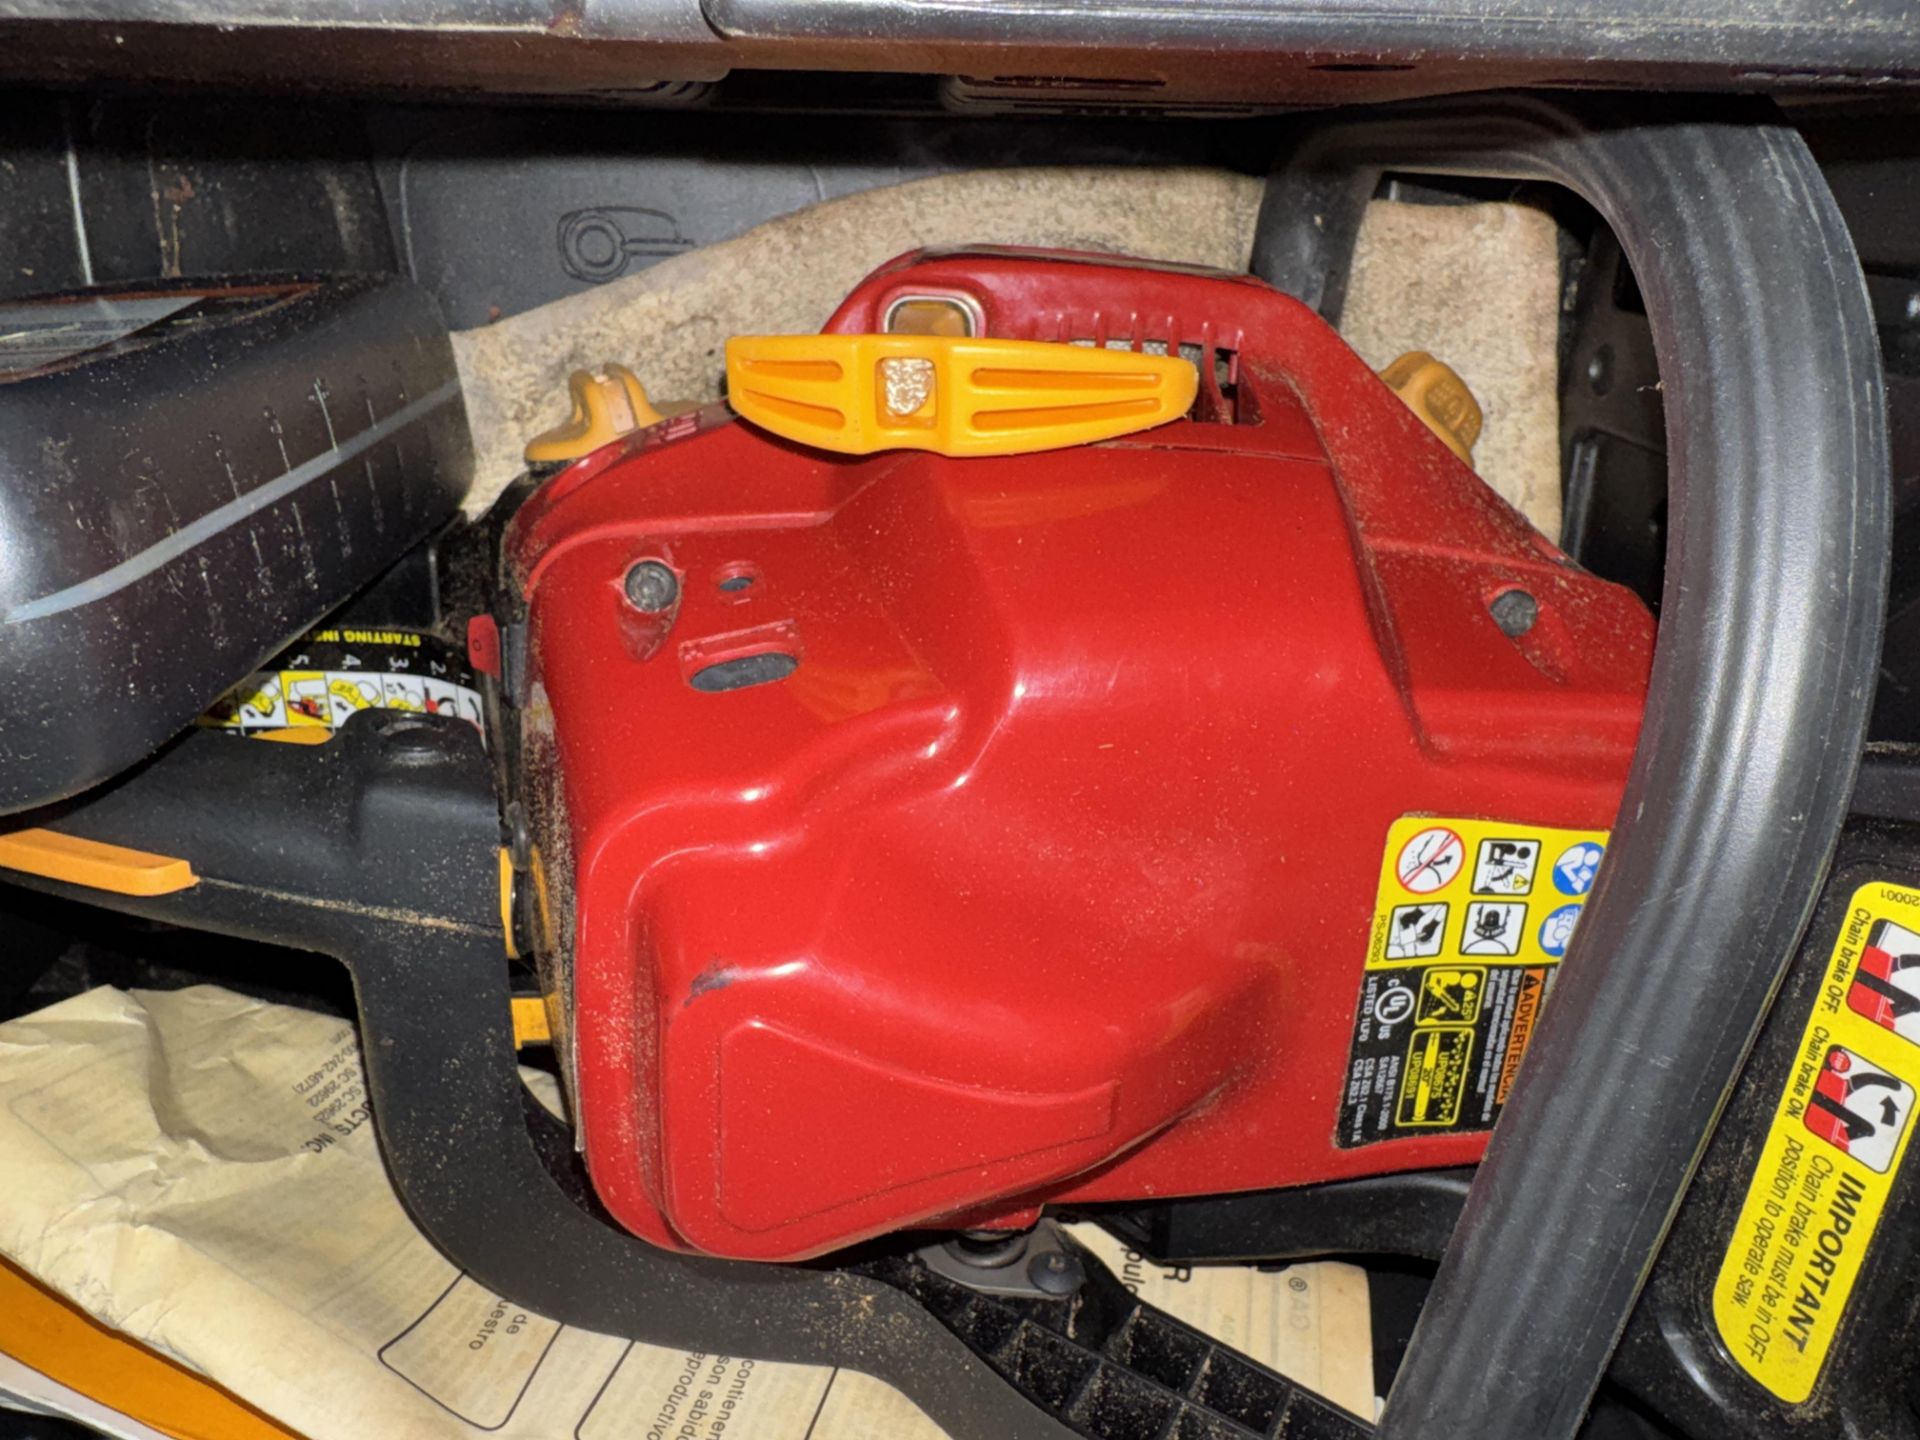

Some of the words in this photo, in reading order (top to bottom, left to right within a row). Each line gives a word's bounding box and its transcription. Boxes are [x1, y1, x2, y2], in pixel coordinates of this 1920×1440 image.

[343, 630, 422, 647] STARTING
[288, 654, 310, 669] 5.
[342, 653, 362, 670] 4.
[389, 656, 410, 672] 3.
[430, 660, 447, 675] 2.
[1845, 907, 1872, 946] Chain
[1831, 946, 1858, 983] brake
[1363, 976, 1378, 1014] LISTED
[1820, 983, 1845, 1015] OFF.
[1806, 1026, 1830, 1063] Chain
[1793, 1061, 1817, 1098] brake
[1784, 1097, 1805, 1120] ON.
[1770, 1134, 1805, 1200] position
[1803, 1154, 1834, 1203] Chain
[1765, 1199, 1787, 1218] to
[1786, 1201, 1817, 1248] brake
[1744, 1217, 1776, 1277] operate
[1783, 1172, 1866, 1353] IMPORTANT
[1769, 1246, 1795, 1292] must
[1730, 1274, 1755, 1309] saw.
[1762, 1285, 1786, 1308] be
[469, 1300, 509, 1350] uestro
[506, 1314, 528, 1334] de
[1756, 1309, 1778, 1326] in
[1744, 1323, 1771, 1364] OFF
[706, 1356, 730, 1385] son
[646, 1350, 706, 1440] eproductivo
